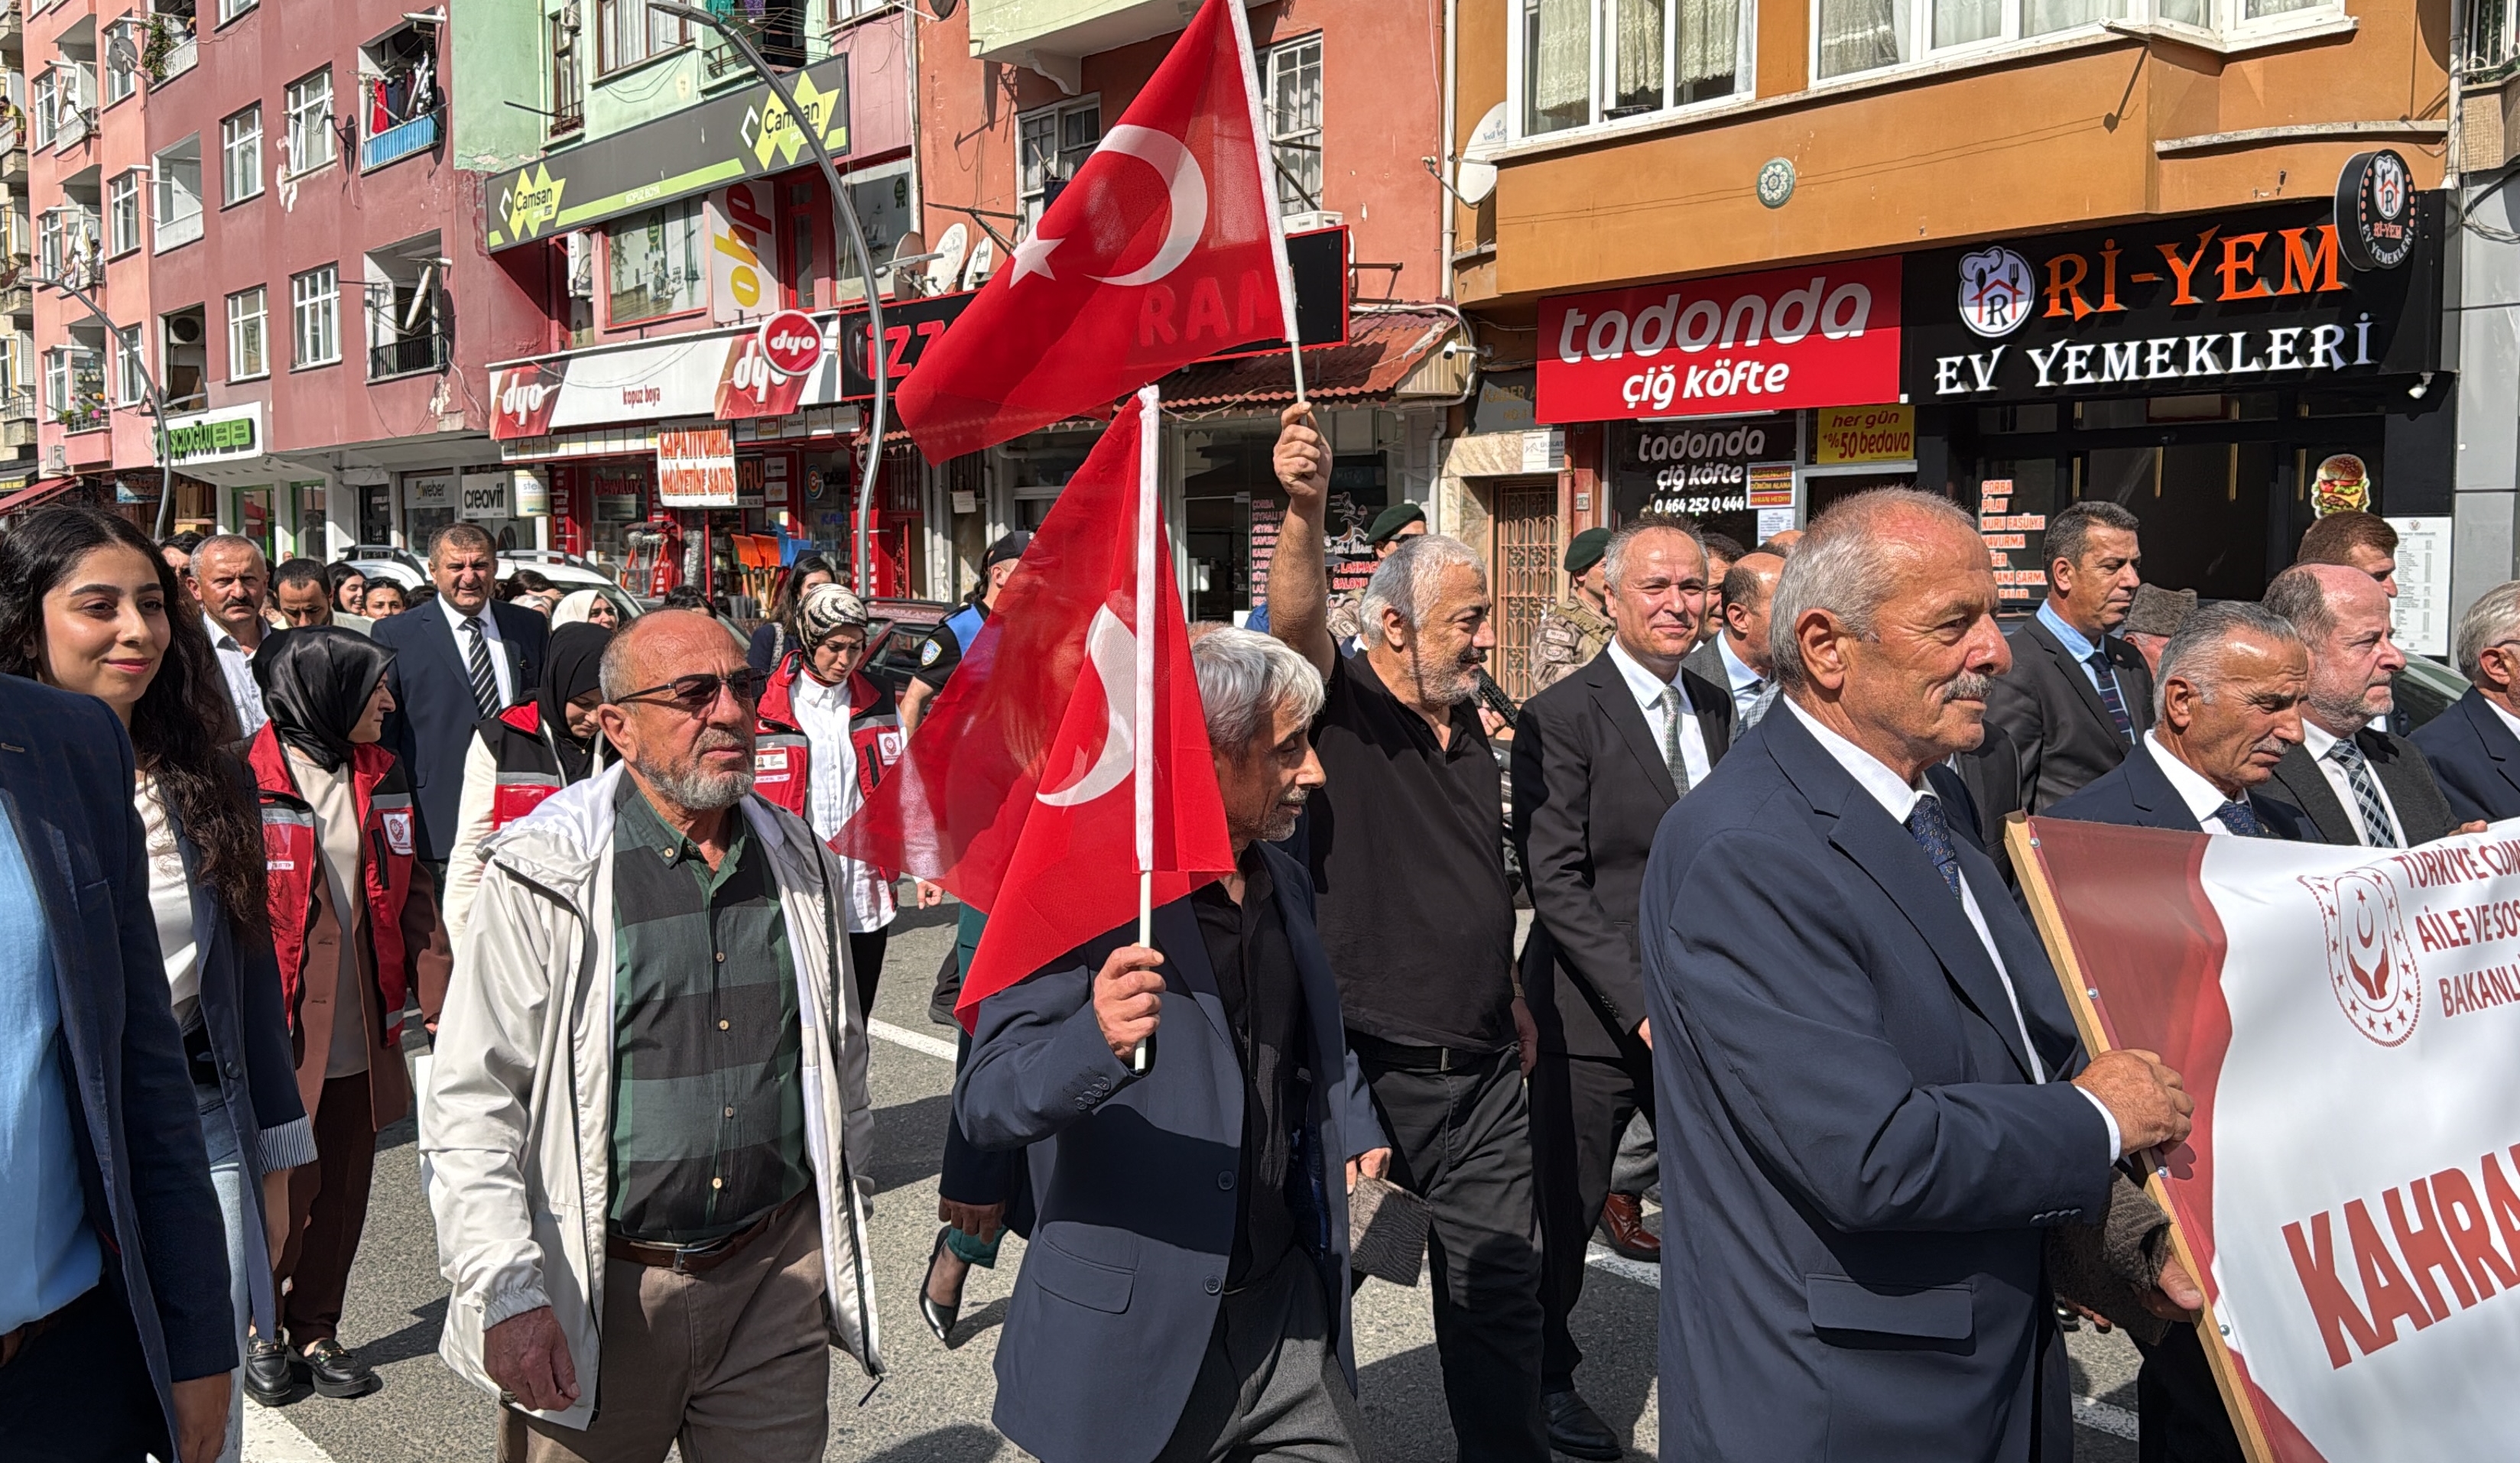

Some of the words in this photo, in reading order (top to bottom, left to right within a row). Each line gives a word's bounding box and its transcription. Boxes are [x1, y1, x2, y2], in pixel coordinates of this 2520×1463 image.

[765, 102, 819, 139] Çaman
[515, 187, 553, 216] Çamsan
[2042, 224, 2344, 322] Rİ-YEM
[1558, 277, 1872, 364] tadonda
[770, 329, 817, 355] dyo
[1934, 344, 2012, 395] EV
[2025, 312, 2374, 388] YEMEKLERİ
[733, 339, 788, 403] dy
[1622, 364, 1676, 410] çiğ
[1682, 358, 1790, 399] köfte
[502, 373, 544, 425] dyo
[623, 386, 643, 408] kopuz
[645, 384, 661, 407] boya
[1832, 414, 1862, 427] her
[1866, 410, 1900, 429] gün
[659, 426, 733, 459] KAPATIYORUZ
[1638, 426, 1765, 462] tadonda
[1859, 429, 1911, 454] bedava
[422, 480, 445, 497] weber
[661, 462, 706, 496] MALİYETİNE
[708, 466, 735, 503] SATIŞ
[1656, 465, 1685, 491] çiğ
[1688, 462, 1744, 485] köfte
[1982, 480, 2012, 498] ÇORBA
[464, 483, 505, 508] creavit
[1655, 499, 1662, 514] 0
[1665, 498, 1686, 513] 464
[1687, 498, 1709, 512] 252
[1712, 497, 1720, 511] 0
[1722, 496, 1745, 511] 444
[1982, 496, 2008, 513] PİLAV
[1982, 517, 2005, 530] KURU
[2388, 843, 2489, 888] TÜRKİYE
[2415, 905, 2471, 952] AİLE
[2464, 904, 2493, 943] VE
[2438, 963, 2520, 1017] BAKANL
